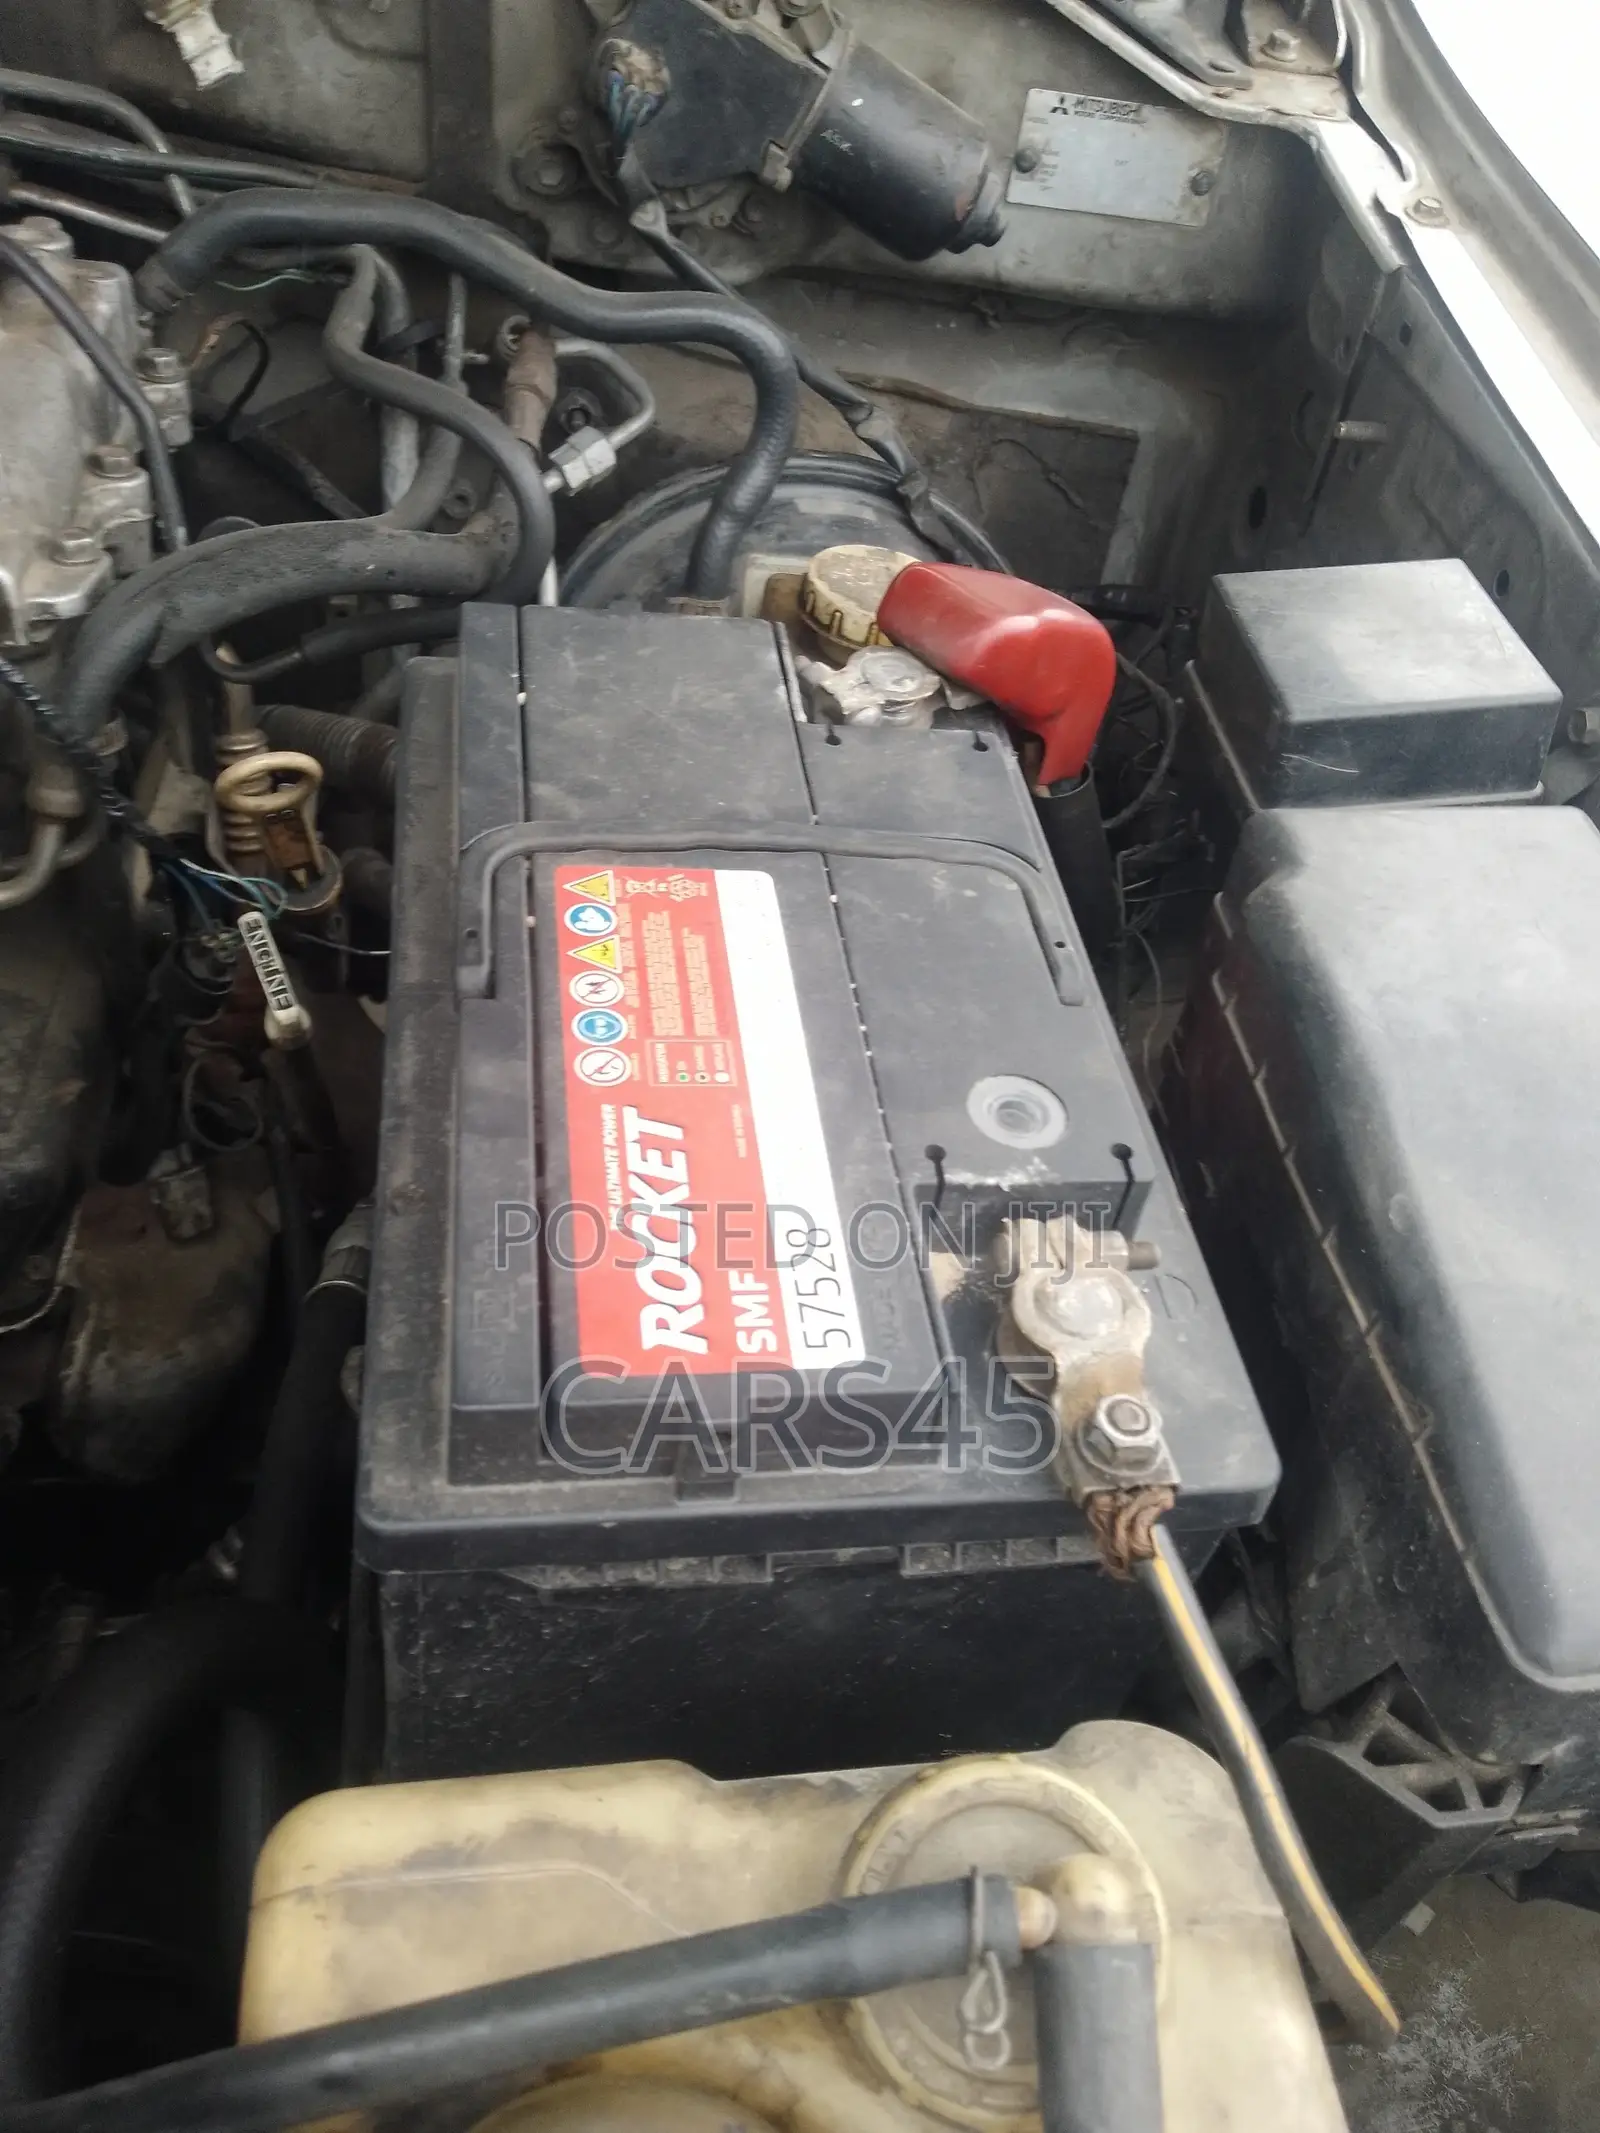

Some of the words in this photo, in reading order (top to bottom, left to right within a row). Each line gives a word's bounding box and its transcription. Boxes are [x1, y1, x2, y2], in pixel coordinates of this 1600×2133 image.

[246, 918, 294, 1011] ENGINE
[600, 1103, 617, 1146] POWER
[604, 1147, 622, 1204] ULTIMATE
[622, 1104, 709, 1355] ROCKET
[728, 1269, 778, 1354] SMF
[785, 1226, 852, 1350] 57528
